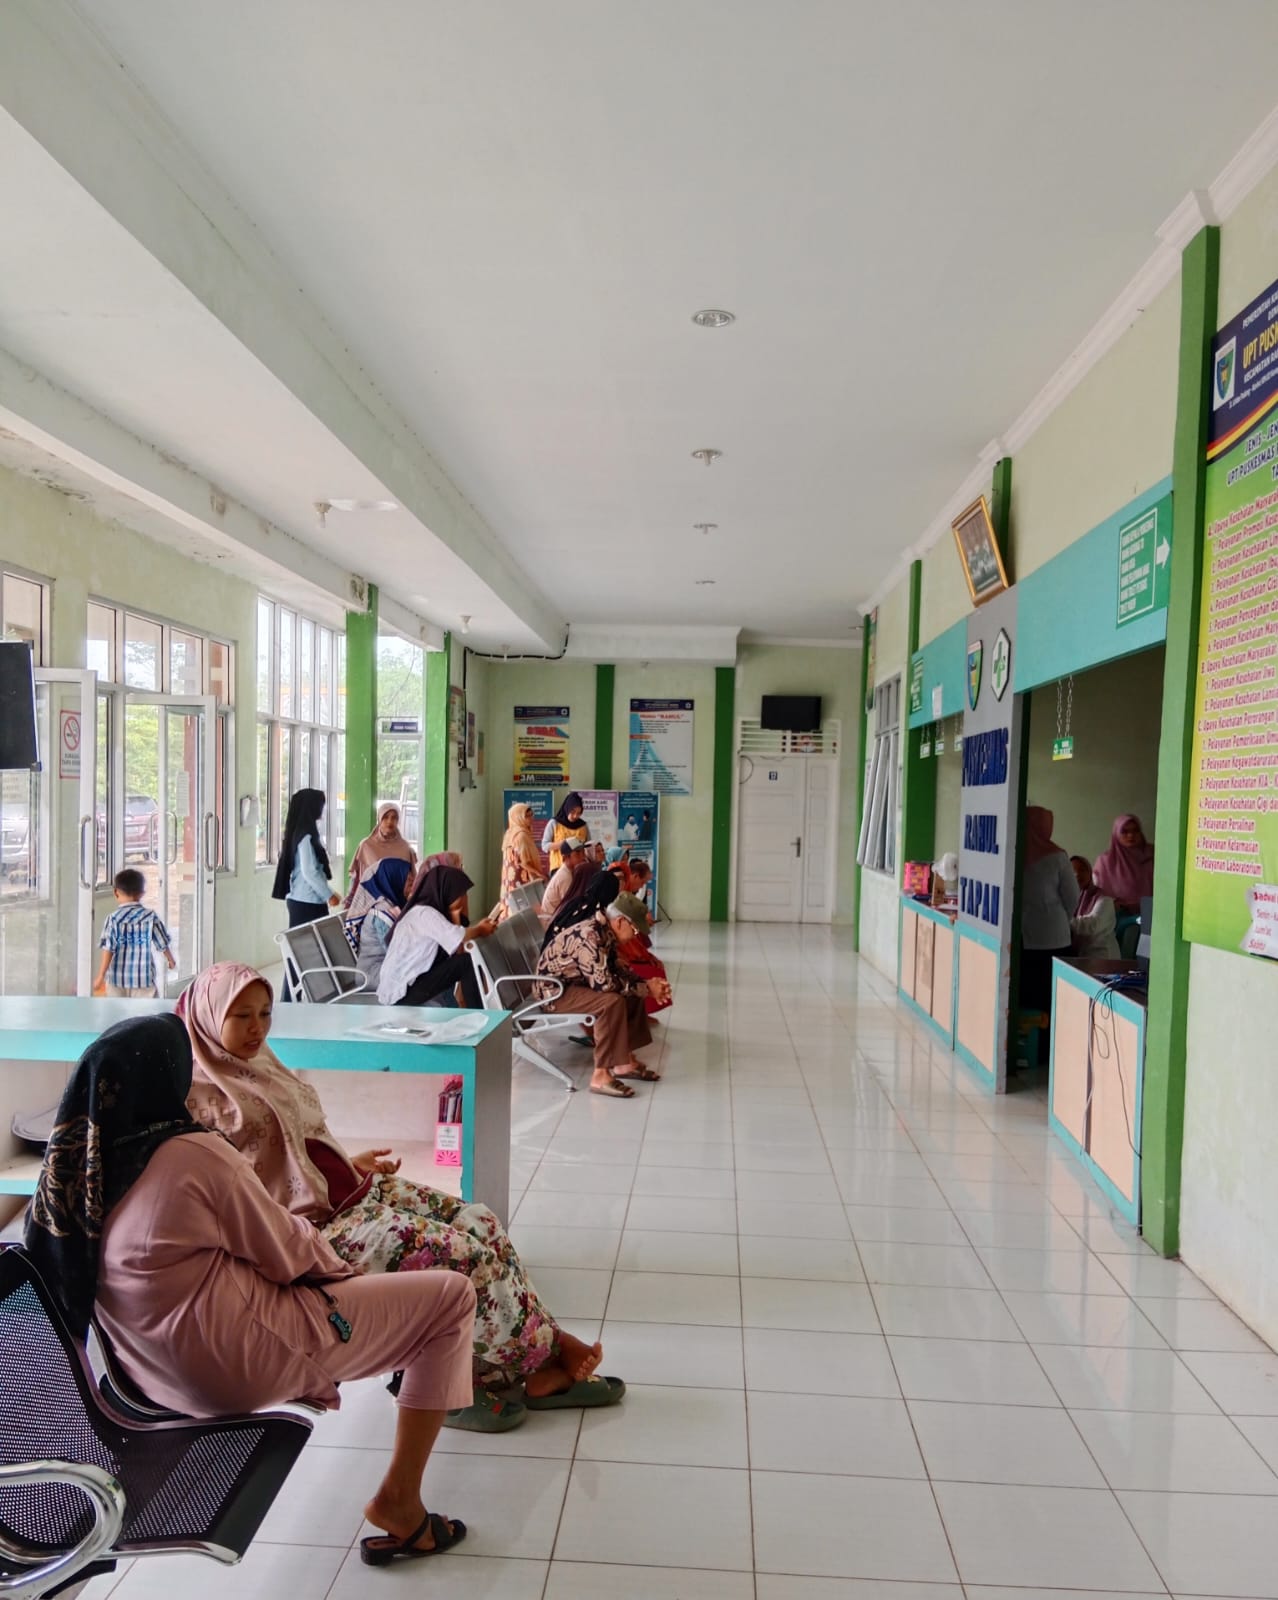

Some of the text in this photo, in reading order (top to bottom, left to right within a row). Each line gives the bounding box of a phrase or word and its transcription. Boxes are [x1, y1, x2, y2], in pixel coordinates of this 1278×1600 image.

[1243, 336, 1258, 369] UPT
[1246, 432, 1262, 455] JENIS
[1240, 444, 1275, 479] PUSKESMAS
[1229, 504, 1254, 524] Kesehatan
[1219, 531, 1242, 551] Pelayanan
[1217, 551, 1241, 572] Pelayanan
[1242, 539, 1268, 559] Kesehatan
[1217, 572, 1240, 591] Pelayanan
[1241, 561, 1267, 579] Kesehatan
[1216, 593, 1239, 611] Pelayanan
[1240, 582, 1266, 600] Kesehatan
[1215, 615, 1238, 631] Pelayanan
[1239, 603, 1270, 622] Pencegahan
[1214, 635, 1237, 651] Pelayanan
[1238, 626, 1264, 643] Kesehatan
[1222, 653, 1246, 669] Kesehatan
[1211, 676, 1235, 691] Pelayanan
[1236, 670, 1262, 686] Kesehatan
[1263, 665, 1276, 680] Jiwa
[1210, 697, 1234, 711] Pelayanan
[1235, 691, 1261, 706] Kesehatan
[1218, 714, 1243, 730] Kesehatan
[1244, 711, 1275, 726] Perorangan
[1208, 737, 1232, 752] Pelayanan
[1232, 733, 1265, 748] Pemeriksaan
[1207, 756, 1231, 771] Pelayanan
[1206, 776, 1229, 792] Pelayanan
[1230, 775, 1256, 789] Kesehatan
[1258, 773, 1268, 788] KIA
[1204, 796, 1228, 812] Pelayanan
[1230, 797, 1255, 810] Kesehatan
[1257, 795, 1268, 813] Gigi
[1203, 815, 1227, 832] Pelayanan
[1229, 817, 1255, 831] Persalinan
[964, 814, 999, 855] RAHUL
[1202, 836, 1226, 852] Pelayanan
[1201, 855, 1225, 872] Pelayanan
[1226, 858, 1262, 876] Laboratorium
[960, 876, 1000, 926] TAPAN
